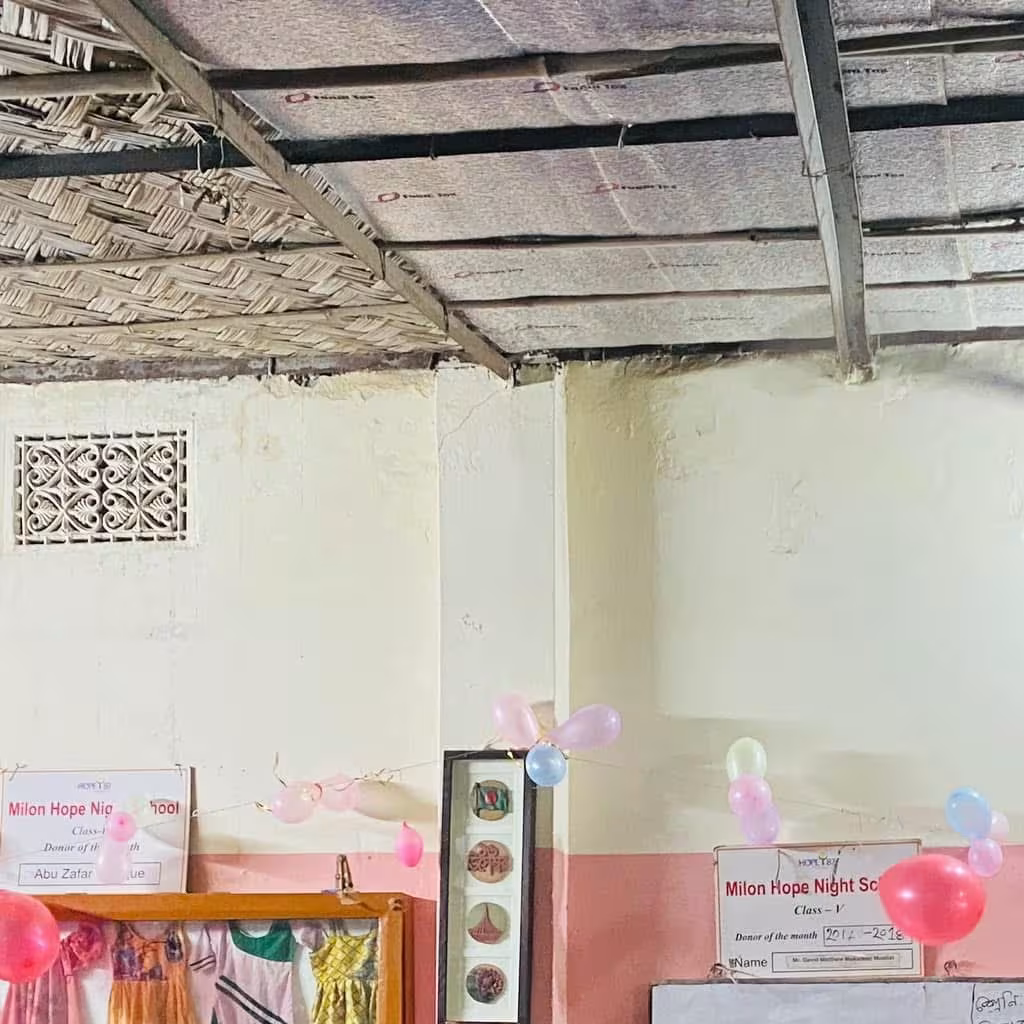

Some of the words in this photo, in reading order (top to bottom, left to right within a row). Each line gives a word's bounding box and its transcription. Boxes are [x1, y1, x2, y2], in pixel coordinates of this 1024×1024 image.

[8, 801, 45, 816] Milon
[50, 801, 86, 819] Hope
[91, 801, 113, 818] Nig
[44, 843, 74, 852] Donor
[78, 843, 88, 854] of
[91, 842, 100, 852] th
[34, 868, 58, 879] Abu
[61, 868, 93, 879] Zafar
[725, 881, 766, 896] Milon
[771, 880, 809, 898] Hope
[814, 879, 855, 897] Night
[794, 904, 822, 915] Class
[836, 904, 845, 914] V
[735, 933, 762, 941] Donor
[764, 932, 774, 943] of
[775, 932, 789, 940] the
[790, 931, 817, 940] month
[735, 957, 768, 968] Name
